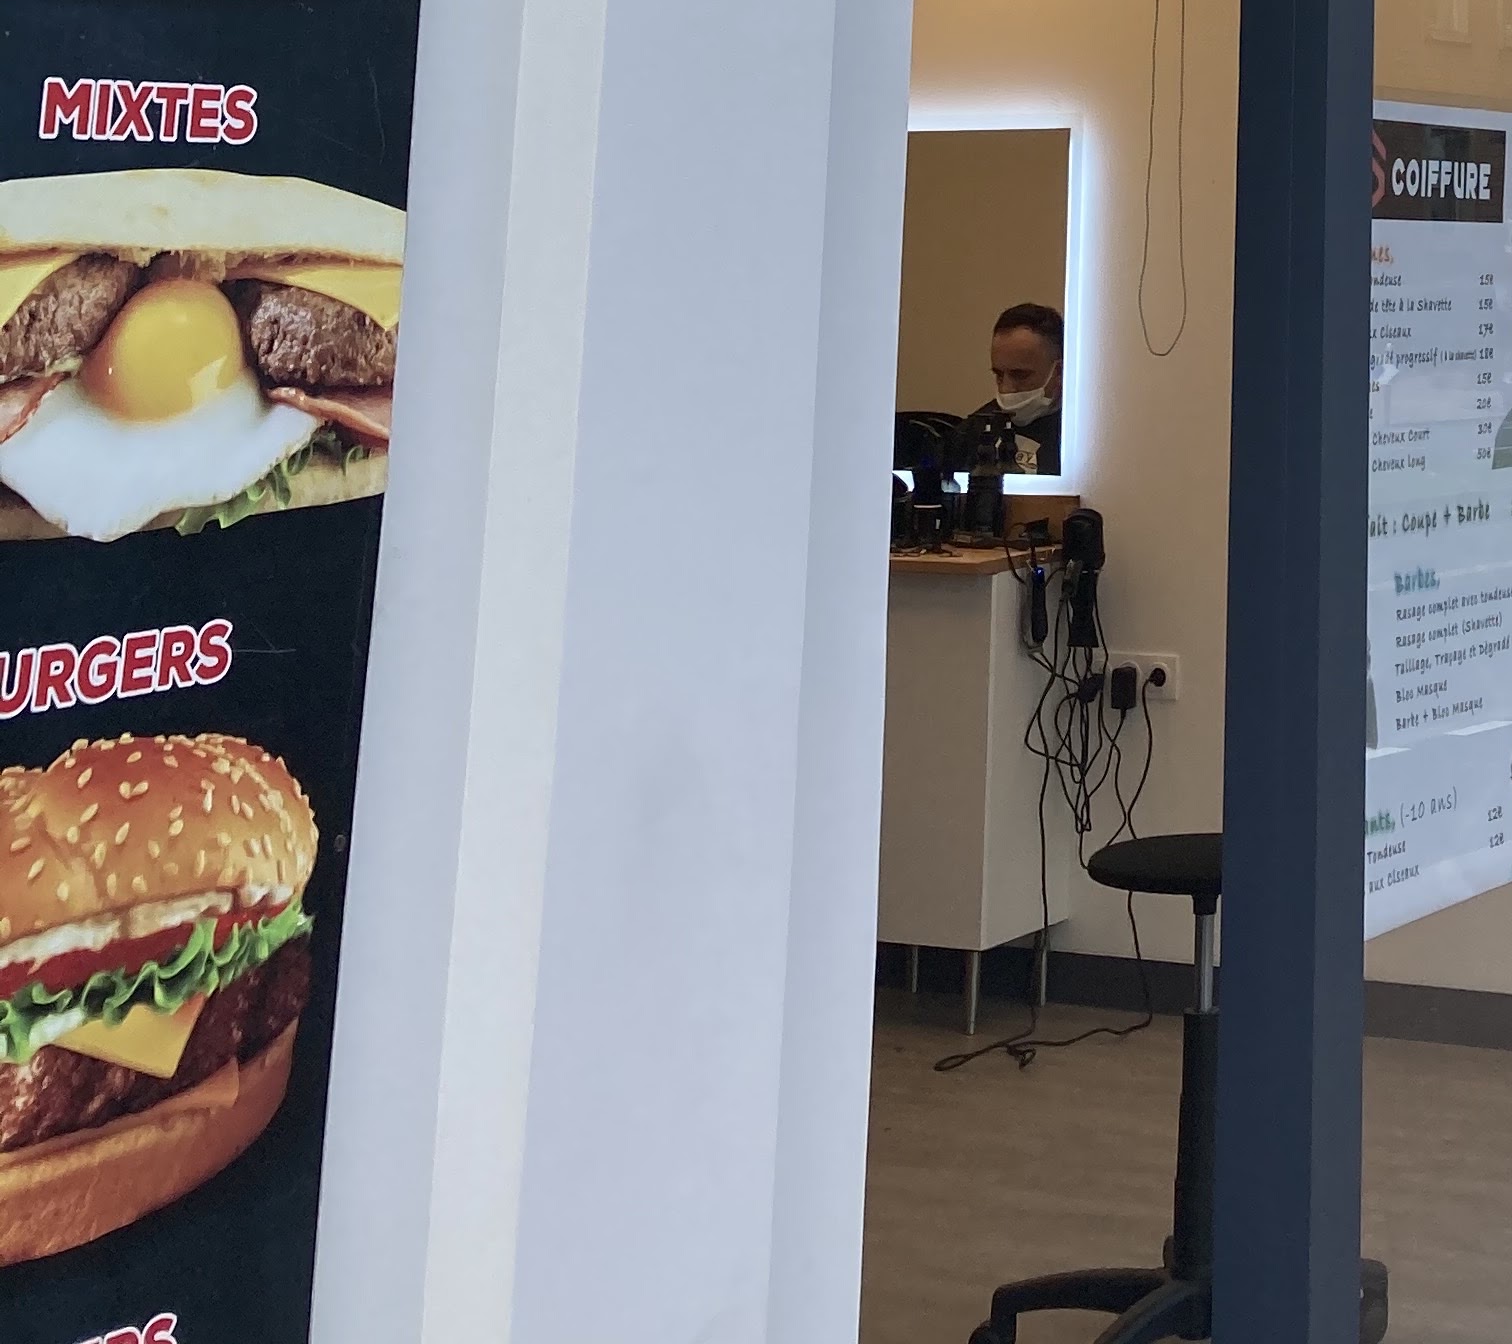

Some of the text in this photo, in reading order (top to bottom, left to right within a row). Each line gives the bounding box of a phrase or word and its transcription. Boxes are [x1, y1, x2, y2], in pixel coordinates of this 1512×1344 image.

[38, 76, 258, 146] MIXTES
[1391, 157, 1492, 200] COIFFURE
[1402, 509, 1438, 537] Coupe
